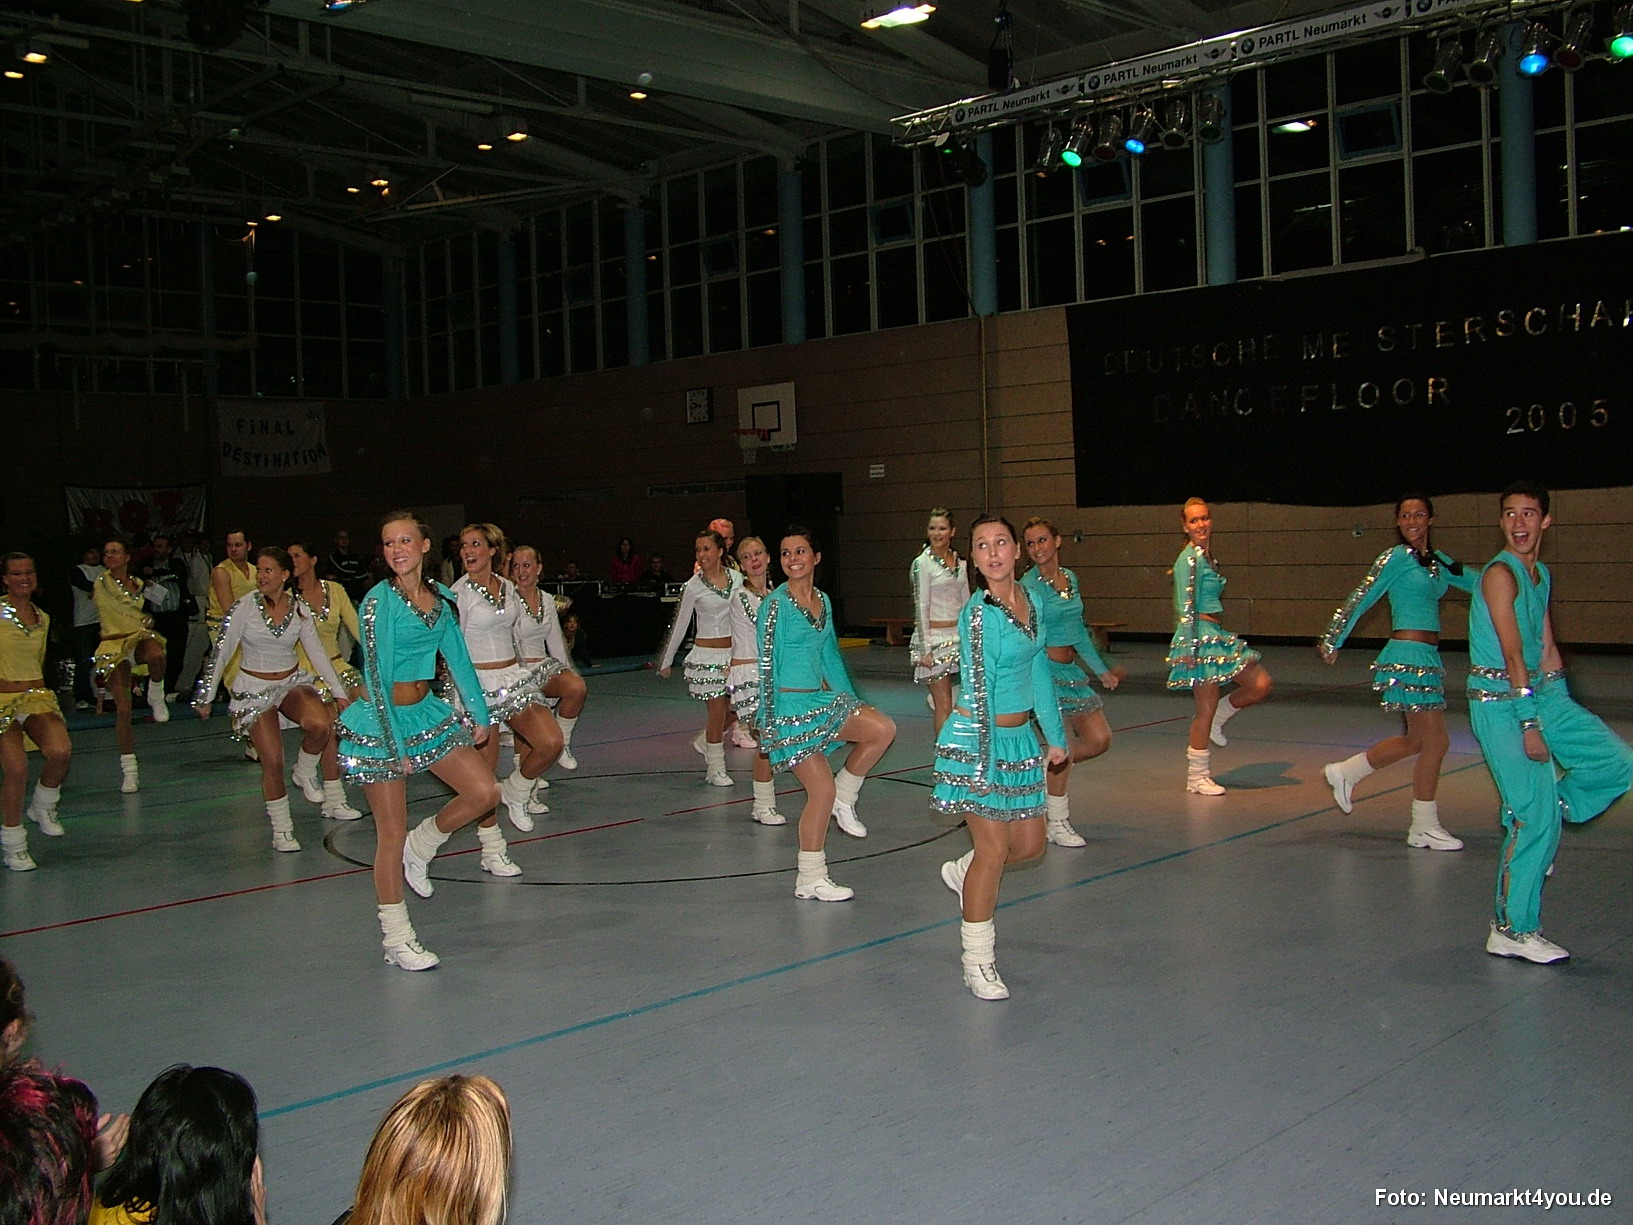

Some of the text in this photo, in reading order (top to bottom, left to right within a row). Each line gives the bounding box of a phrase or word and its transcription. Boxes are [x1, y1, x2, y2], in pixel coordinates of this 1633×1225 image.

[1258, 13, 1367, 48] PARTL Neumarkt
[1103, 54, 1198, 85] PARTL Neumarkt
[967, 90, 1050, 118] PARTL Neumarkt
[1103, 334, 1280, 377] DEUTSCHE
[1505, 399, 1610, 434] 2005
